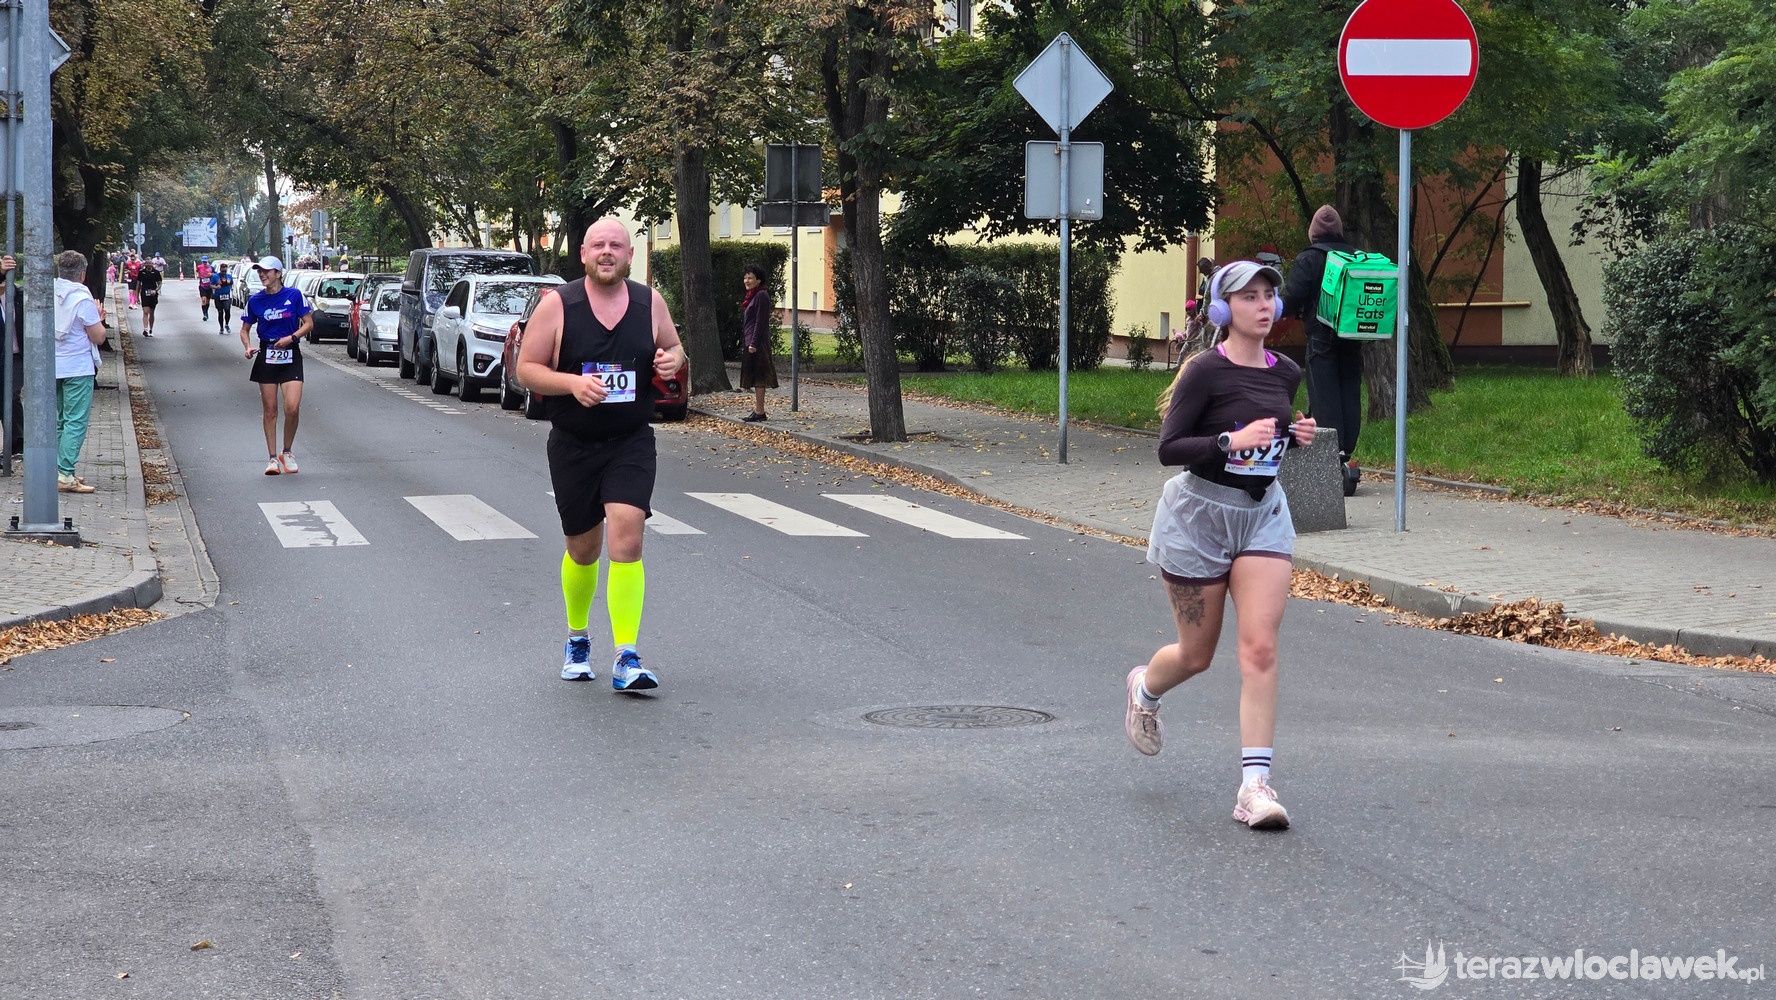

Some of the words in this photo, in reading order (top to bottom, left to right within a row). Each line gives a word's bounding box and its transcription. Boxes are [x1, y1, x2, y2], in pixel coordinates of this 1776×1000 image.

[1358, 294, 1387, 306] Uber
[1356, 308, 1384, 319] Eats
[270, 350, 289, 360] 220
